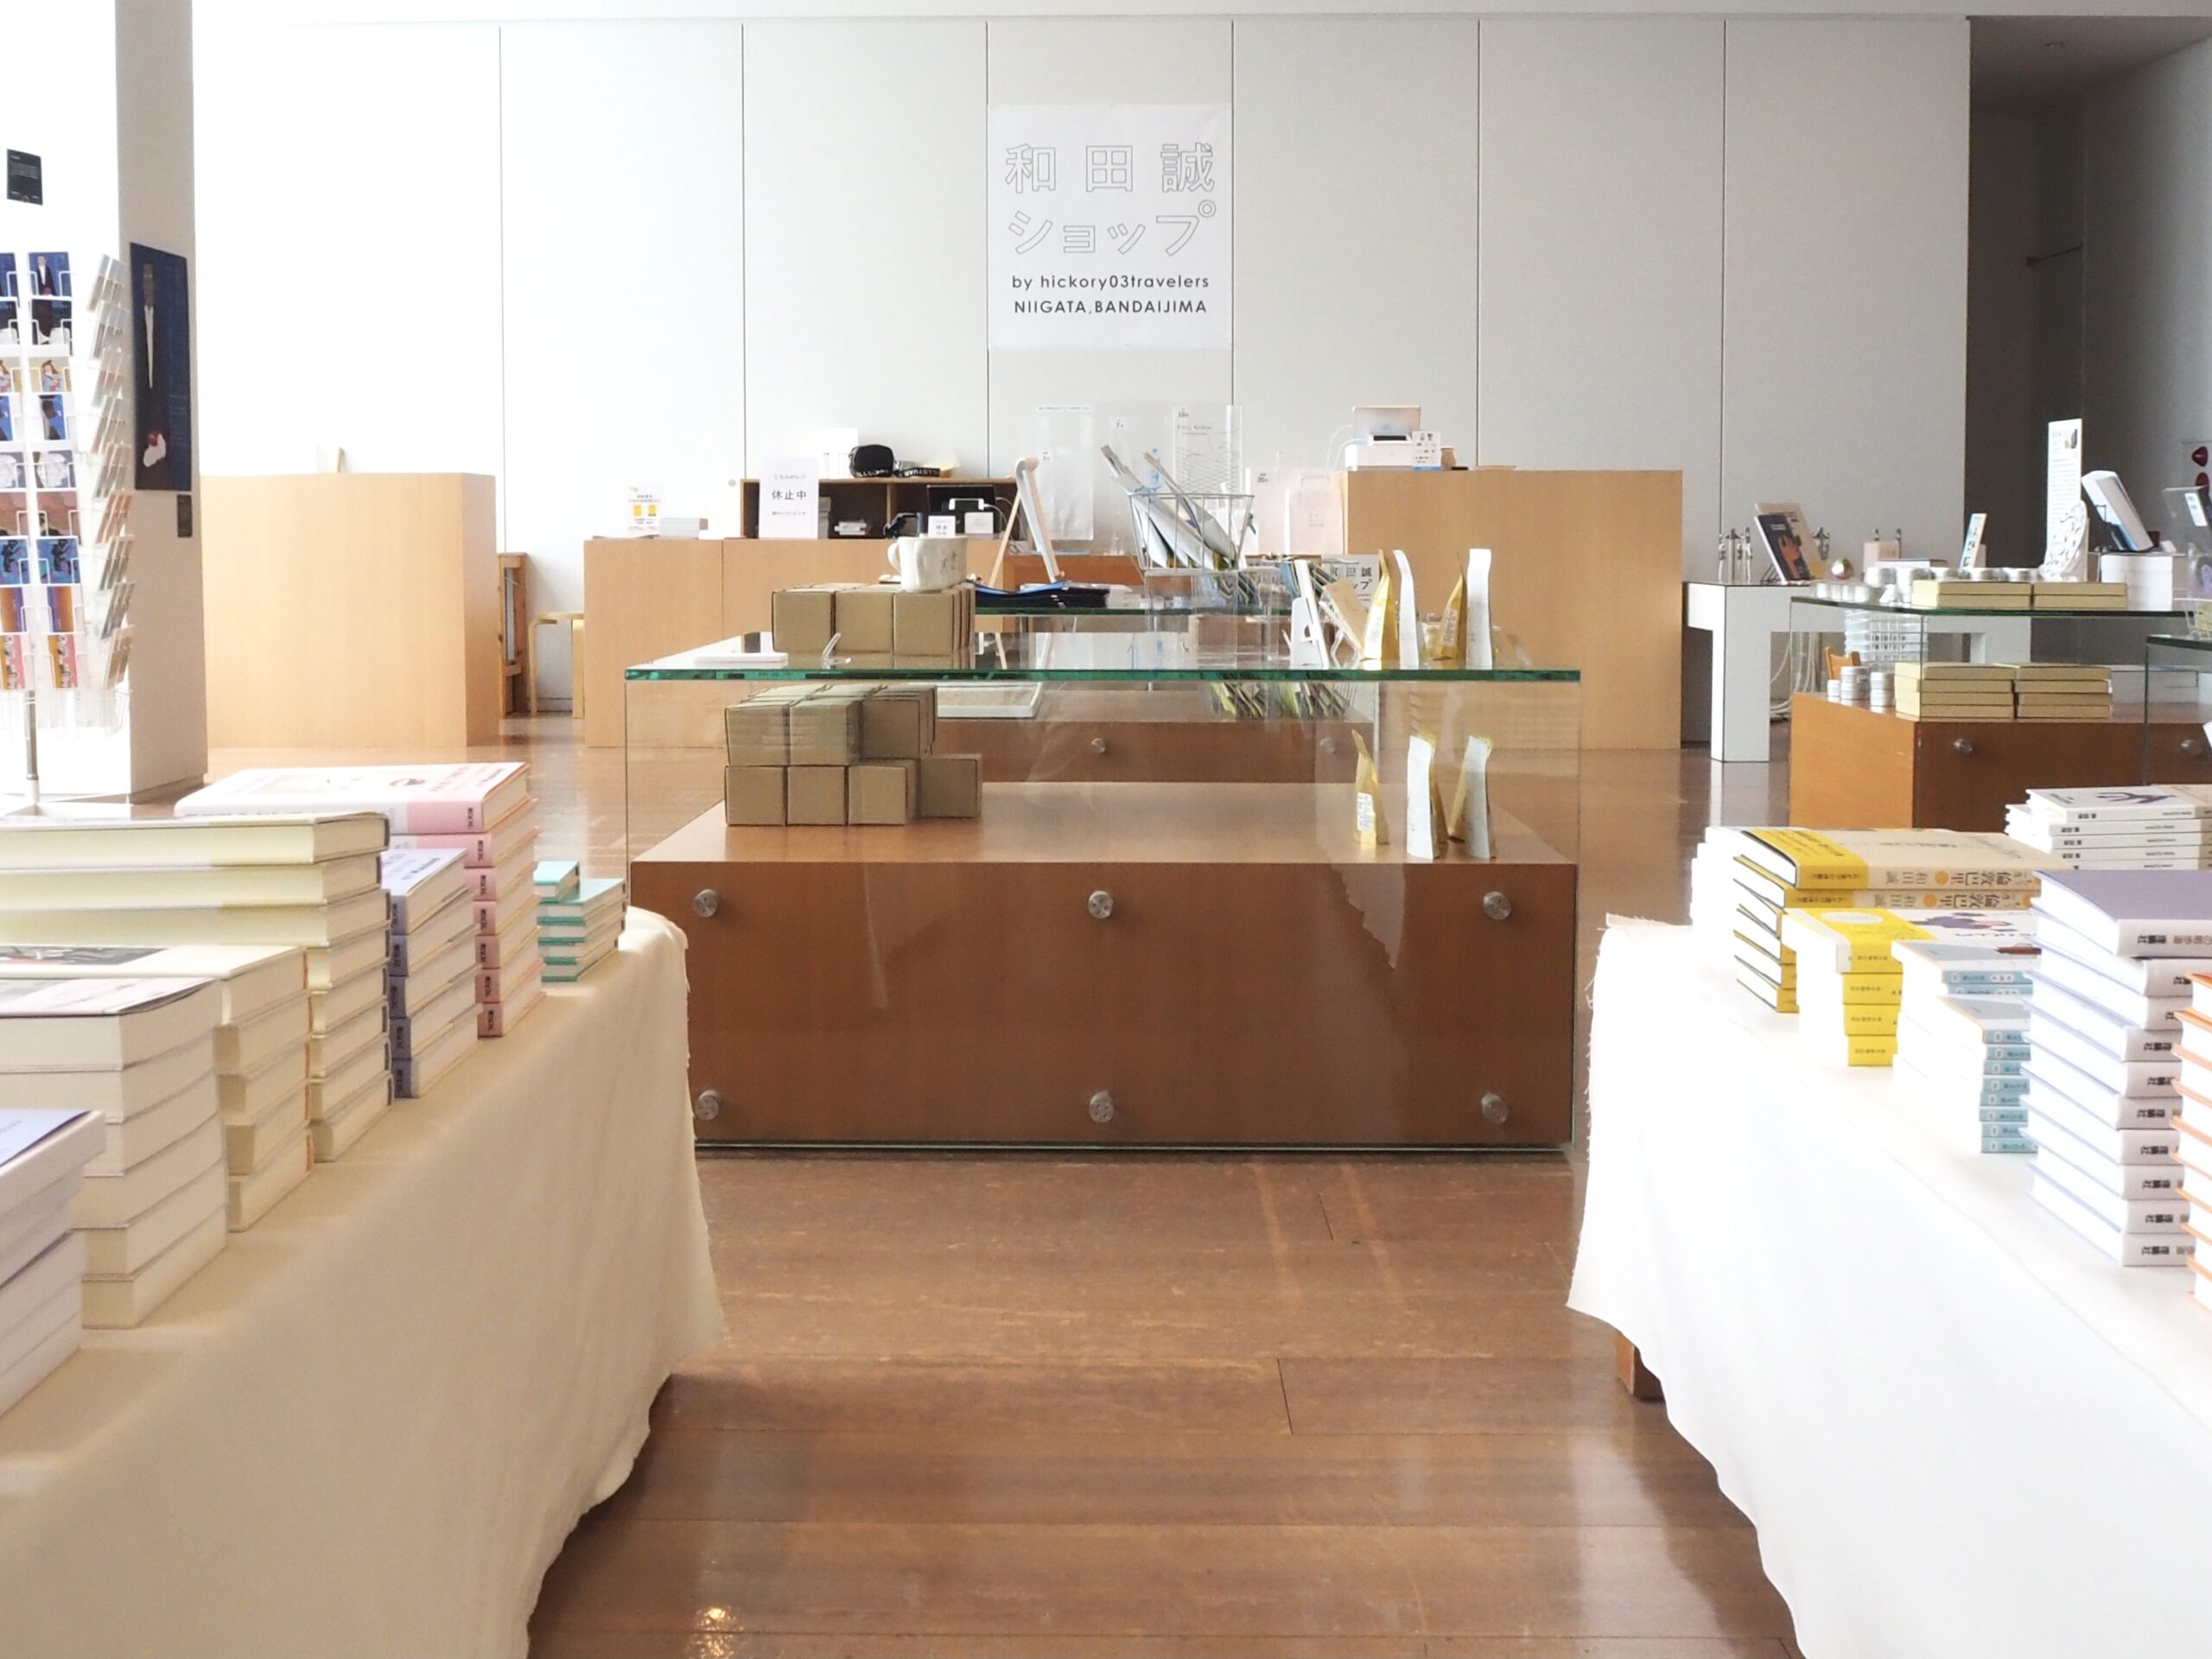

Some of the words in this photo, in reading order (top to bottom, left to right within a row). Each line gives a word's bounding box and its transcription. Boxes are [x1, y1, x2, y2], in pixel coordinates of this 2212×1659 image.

[1005, 142, 1216, 194] 和田誠
[1007, 199, 1217, 257] ショップ
[1012, 275, 1033, 291] by
[1040, 275, 1210, 291] hickory03travelers
[1014, 300, 1208, 315] NIIGATA,BANDAIJIMA
[771, 488, 808, 501] 休止中
[1950, 870, 2012, 887] 倫敦巴里
[1939, 893, 2000, 908] 倫敦巴里
